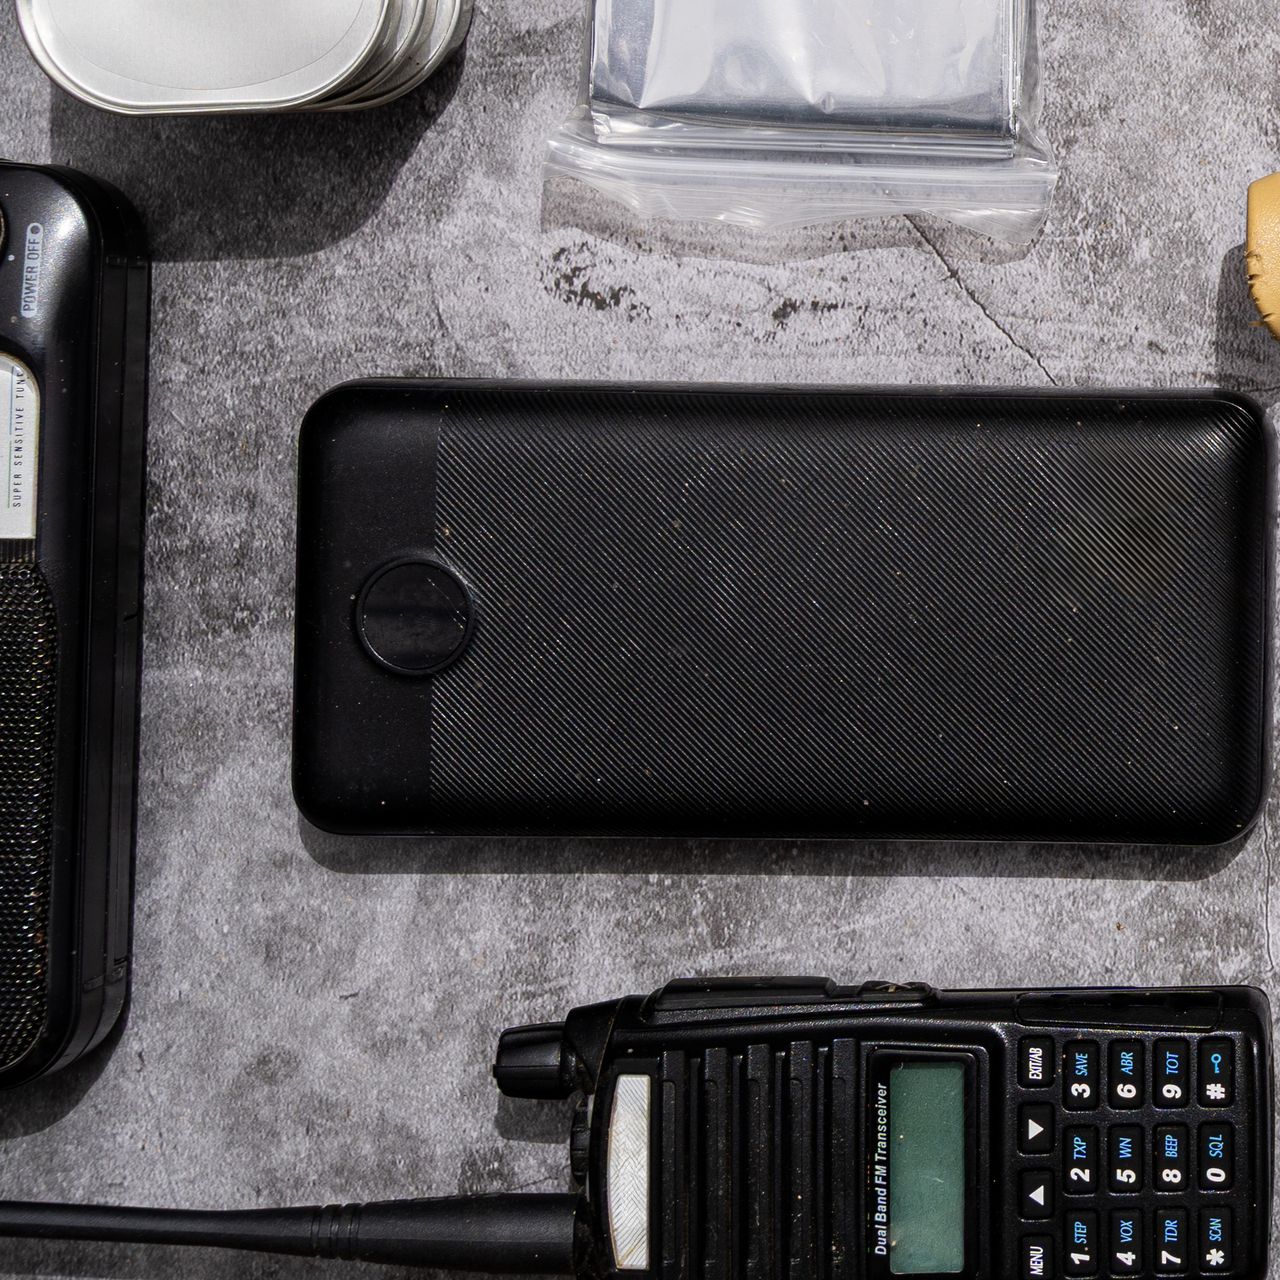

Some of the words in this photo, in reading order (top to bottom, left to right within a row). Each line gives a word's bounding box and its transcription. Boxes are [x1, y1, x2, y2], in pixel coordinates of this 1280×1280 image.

[27, 238, 40, 261] OFF
[23, 266, 39, 312] POWER
[14, 407, 25, 467] SENSITIVE
[13, 473, 22, 508] SUPER
[1029, 1048, 1042, 1079] EXIT/AB
[1076, 1053, 1087, 1076] SAVE
[1121, 1052, 1133, 1074] ABR
[1166, 1052, 1178, 1074] TOT
[1071, 1083, 1090, 1098] 3
[1117, 1084, 1136, 1098] 6
[1162, 1084, 1181, 1098] 9
[875, 1083, 887, 1161] Transceiver
[1074, 1137, 1086, 1159] TXP
[1120, 1138, 1131, 1158] WN
[1165, 1135, 1177, 1157] BEEP
[1209, 1135, 1223, 1157] SQL
[875, 1164, 887, 1185] FM
[1070, 1168, 1089, 1182] 2
[1117, 1169, 1136, 1183] 5
[1162, 1169, 1181, 1183] 8
[1207, 1168, 1225, 1182] 0
[875, 1187, 887, 1222] Band
[875, 1224, 887, 1255] Dual
[1075, 1222, 1086, 1243] STEP
[1120, 1220, 1132, 1242] VOX
[1165, 1220, 1177, 1242] TDR
[1209, 1218, 1221, 1241] SCAN
[1030, 1246, 1043, 1275] MENU
[1071, 1253, 1090, 1264] 1
[1117, 1252, 1135, 1265] 4
[1162, 1251, 1181, 1264] 7
